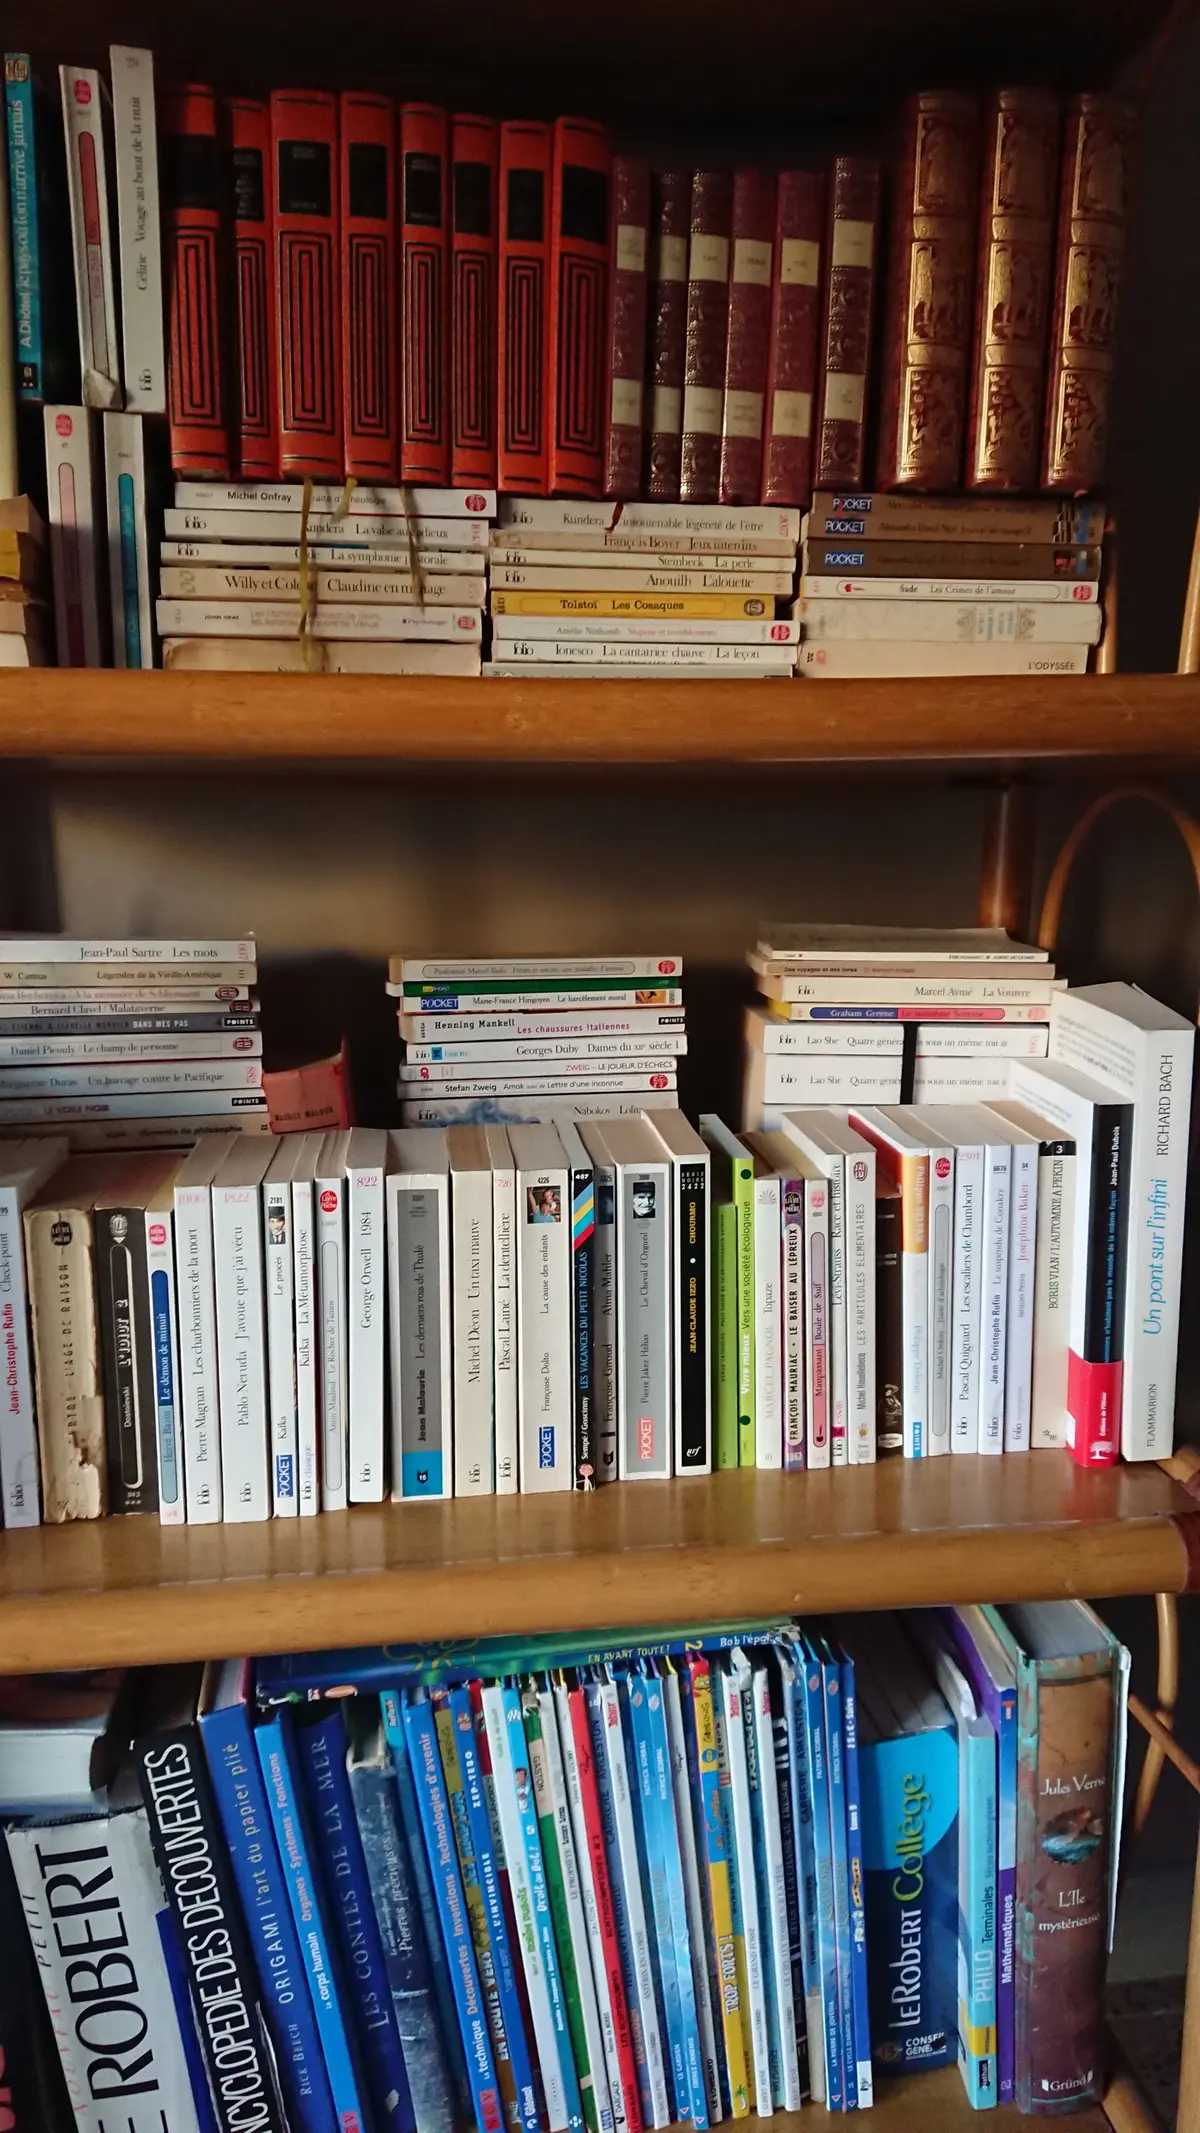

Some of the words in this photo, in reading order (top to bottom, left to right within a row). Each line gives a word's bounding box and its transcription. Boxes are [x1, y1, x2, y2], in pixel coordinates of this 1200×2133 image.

[129, 97, 141, 121] nuit
[132, 124, 140, 134] la
[132, 139, 142, 152] de
[133, 156, 143, 183] bout
[135, 186, 143, 201] au
[134, 205, 147, 242] Voyage
[137, 253, 147, 290] Céline
[228, 491, 259, 500] Michel
[260, 492, 292, 503] Onfray
[825, 519, 865, 533] POCKET
[657, 556, 704, 567] Steinbeck
[714, 557, 727, 568] La
[731, 558, 755, 570] perle
[825, 553, 864, 565] POCKET
[225, 576, 261, 592] Willy
[262, 580, 272, 590] et
[327, 580, 381, 593] Claudine
[384, 584, 397, 594] en
[646, 575, 691, 587] Anouilh
[703, 576, 754, 587] L'alouette
[900, 585, 917, 593] Sade
[930, 586, 943, 594] Les
[945, 586, 972, 594] Crimes
[986, 586, 1015, 595] l'amour
[560, 600, 597, 609] Tolstoï
[612, 601, 630, 609] Les
[634, 601, 684, 611] Cosaques
[556, 645, 593, 655] Ionesco
[603, 646, 616, 656] La
[619, 647, 669, 657] cantatrice
[672, 647, 705, 658] chauve
[716, 647, 730, 658] La
[732, 649, 759, 661] leçon
[1028, 660, 1074, 671] L'ODYSSÉE
[80, 947, 128, 960] Jean-Paul
[132, 948, 162, 958] Sartre
[172, 948, 190, 958] Les
[193, 949, 218, 957] mots
[421, 996, 458, 1009] POCKET
[472, 995, 516, 1005] Marie-France
[557, 994, 568, 1003] Le
[570, 994, 606, 1003] harcèlement
[608, 994, 626, 1002] moral
[915, 986, 945, 996] Marcel
[947, 986, 973, 996] Aymé
[983, 988, 994, 997] La
[997, 988, 1031, 998] Vouivre
[133, 1021, 152, 1029] DANS
[156, 1020, 171, 1028] MES
[226, 1018, 254, 1026] POINTS
[434, 1020, 474, 1030] Henning
[479, 1019, 515, 1028] Mankell
[830, 1009, 862, 1018] Graham
[535, 1024, 583, 1033] chaussures
[608, 1062, 634, 1070] JOUEUR
[637, 1061, 672, 1069] D'ÉCHECS
[1159, 1055, 1173, 1091] BACH
[1157, 1096, 1171, 1156] RICHARD
[960, 1185, 973, 1238] Chambord
[1146, 1179, 1167, 1228] l'infini
[360, 1211, 372, 1237] 1984
[689, 1202, 697, 1243] CHOURMO
[741, 1201, 751, 1252] écologique
[188, 1228, 197, 1254] mort
[470, 1218, 480, 1255] mauve
[540, 1234, 548, 1261] enfants
[788, 1228, 798, 1265] LÉPREUX
[962, 1240, 972, 1252] de
[1148, 1231, 1164, 1260] sur
[188, 1257, 198, 1267] la
[360, 1248, 372, 1284] Orwell
[469, 1259, 480, 1279] taxi
[540, 1264, 549, 1277] des
[578, 1252, 587, 1287] NICOLAS
[741, 1255, 750, 1288] société
[961, 1255, 972, 1294] escaliers
[189, 1269, 198, 1283] de
[689, 1277, 697, 1296] IZZO
[789, 1272, 797, 1283] AU
[1146, 1263, 1164, 1304] pont
[115, 1299, 128, 1308] 2
[468, 1281, 480, 1299] Un
[541, 1280, 549, 1301] cause
[579, 1290, 587, 1312] PETIT
[361, 1288, 373, 1328] George
[541, 1304, 549, 1313] La
[789, 1290, 798, 1320] BAISER
[960, 1296, 972, 1312] Les
[189, 1286, 202, 1354] charbonniers
[468, 1310, 480, 1341] Déon
[580, 1316, 588, 1327] DU
[741, 1310, 750, 1330] Vers
[789, 1324, 798, 1335] LE
[1144, 1309, 1160, 1334] Un
[118, 1318, 130, 1366] L'IDIOT
[580, 1331, 588, 1373] VACANCES
[741, 1334, 750, 1363] mieux
[959, 1324, 972, 1369] Quignard
[192, 1357, 203, 1375] Les
[468, 1346, 480, 1382] Michel
[541, 1353, 550, 1373] Dolto
[789, 1353, 798, 1392] MAURIAC
[541, 1376, 552, 1411] Françoise
[580, 1376, 588, 1389] LES
[741, 1367, 751, 1394] Vivre
[959, 1372, 970, 1400] Pascal
[122, 1387, 132, 1428] Dostoïevski
[194, 1386, 207, 1428] Magnan
[581, 1397, 591, 1430] Goscinny
[789, 1398, 800, 1439] FRANÇOIS
[1147, 1384, 1157, 1447] FLAMMARION
[196, 1432, 207, 1462] Pierre
[541, 1427, 552, 1468] POCKET
[581, 1436, 590, 1460] Sempé
[588, 1654, 600, 1663] EN
[603, 1649, 634, 1662] AVANT
[636, 1645, 670, 1658] TOUTE!
[684, 1640, 703, 1652] 2
[223, 1744, 242, 1776] plié
[420, 1733, 438, 1784] d'avenir
[1040, 1779, 1070, 1796] Jules
[233, 1784, 259, 1835] papier
[143, 1743, 224, 1929] DECOUVERTES
[428, 1787, 451, 1865] Technologies
[893, 1773, 932, 1901] Collège
[245, 1844, 262, 1863] du
[253, 1869, 272, 1907] l'art
[444, 1874, 465, 1936] Inventions
[983, 1886, 994, 1943] Terminales
[1002, 1895, 1013, 1983] Mathématiques
[190, 1930, 237, 1979] DES
[261, 1913, 294, 2004] ORIGAMI
[35, 1845, 160, 2099] ROBERT
[458, 1945, 478, 2014] Découvertes
[976, 1950, 994, 2003] PHILO
[471, 2020, 489, 2071] technique
[1050, 2079, 1087, 2091] Gründ
